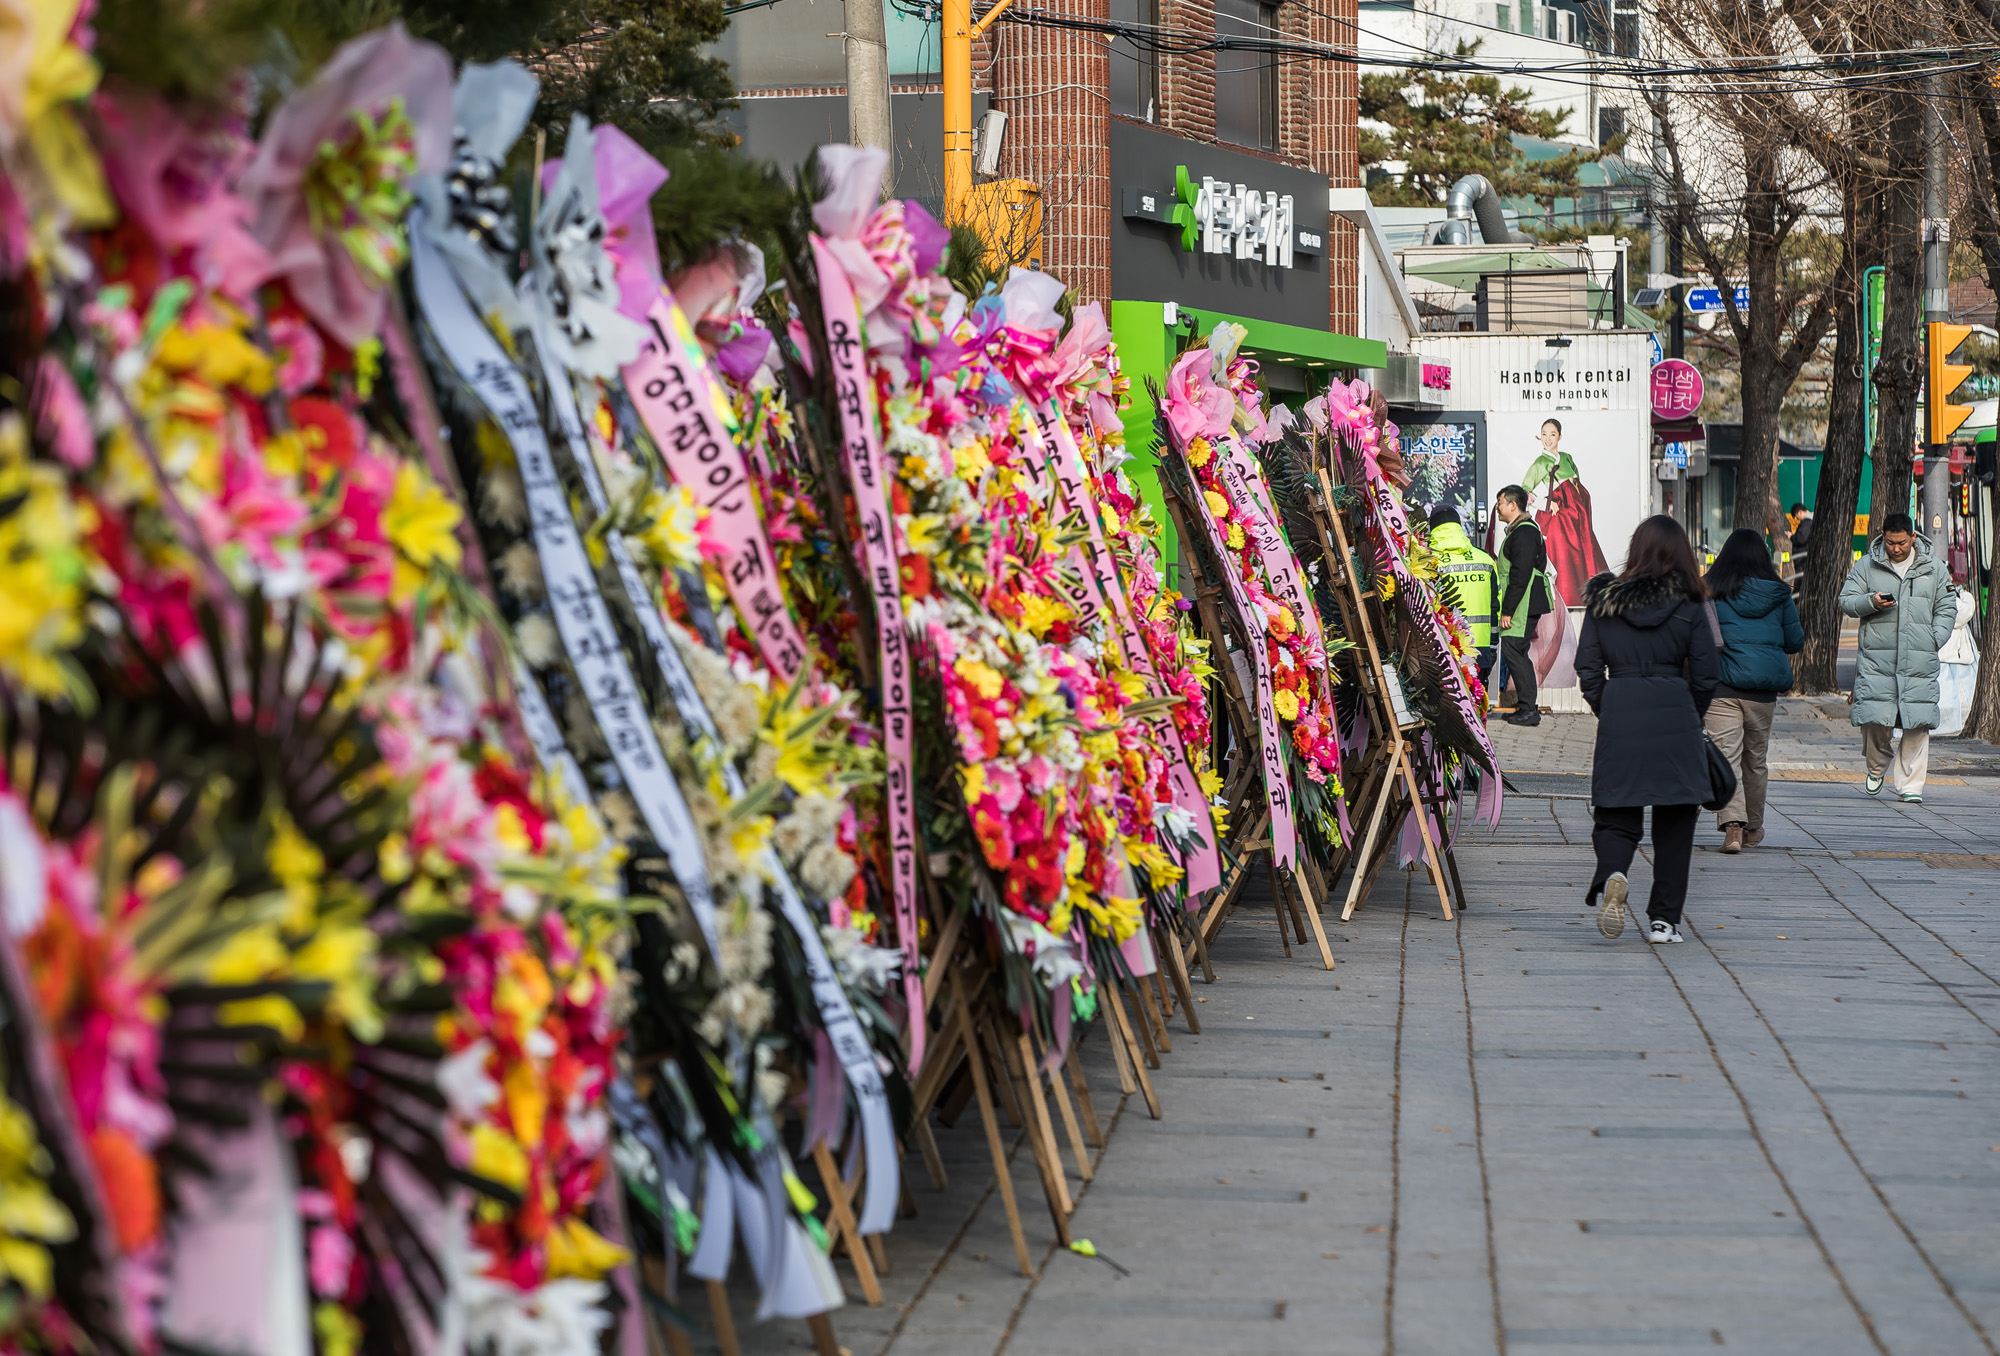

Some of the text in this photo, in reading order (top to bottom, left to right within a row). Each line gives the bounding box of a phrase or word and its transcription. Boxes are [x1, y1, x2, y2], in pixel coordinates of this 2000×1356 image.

[1500, 367, 1630, 384] Hanbok rental
[1655, 368, 1694, 390] 인생
[1522, 388, 1609, 400] Miso Hanbok
[1653, 390, 1693, 411] 네컷
[1399, 437, 1466, 455] 미소한복
[1446, 574, 1486, 584] OLICE
